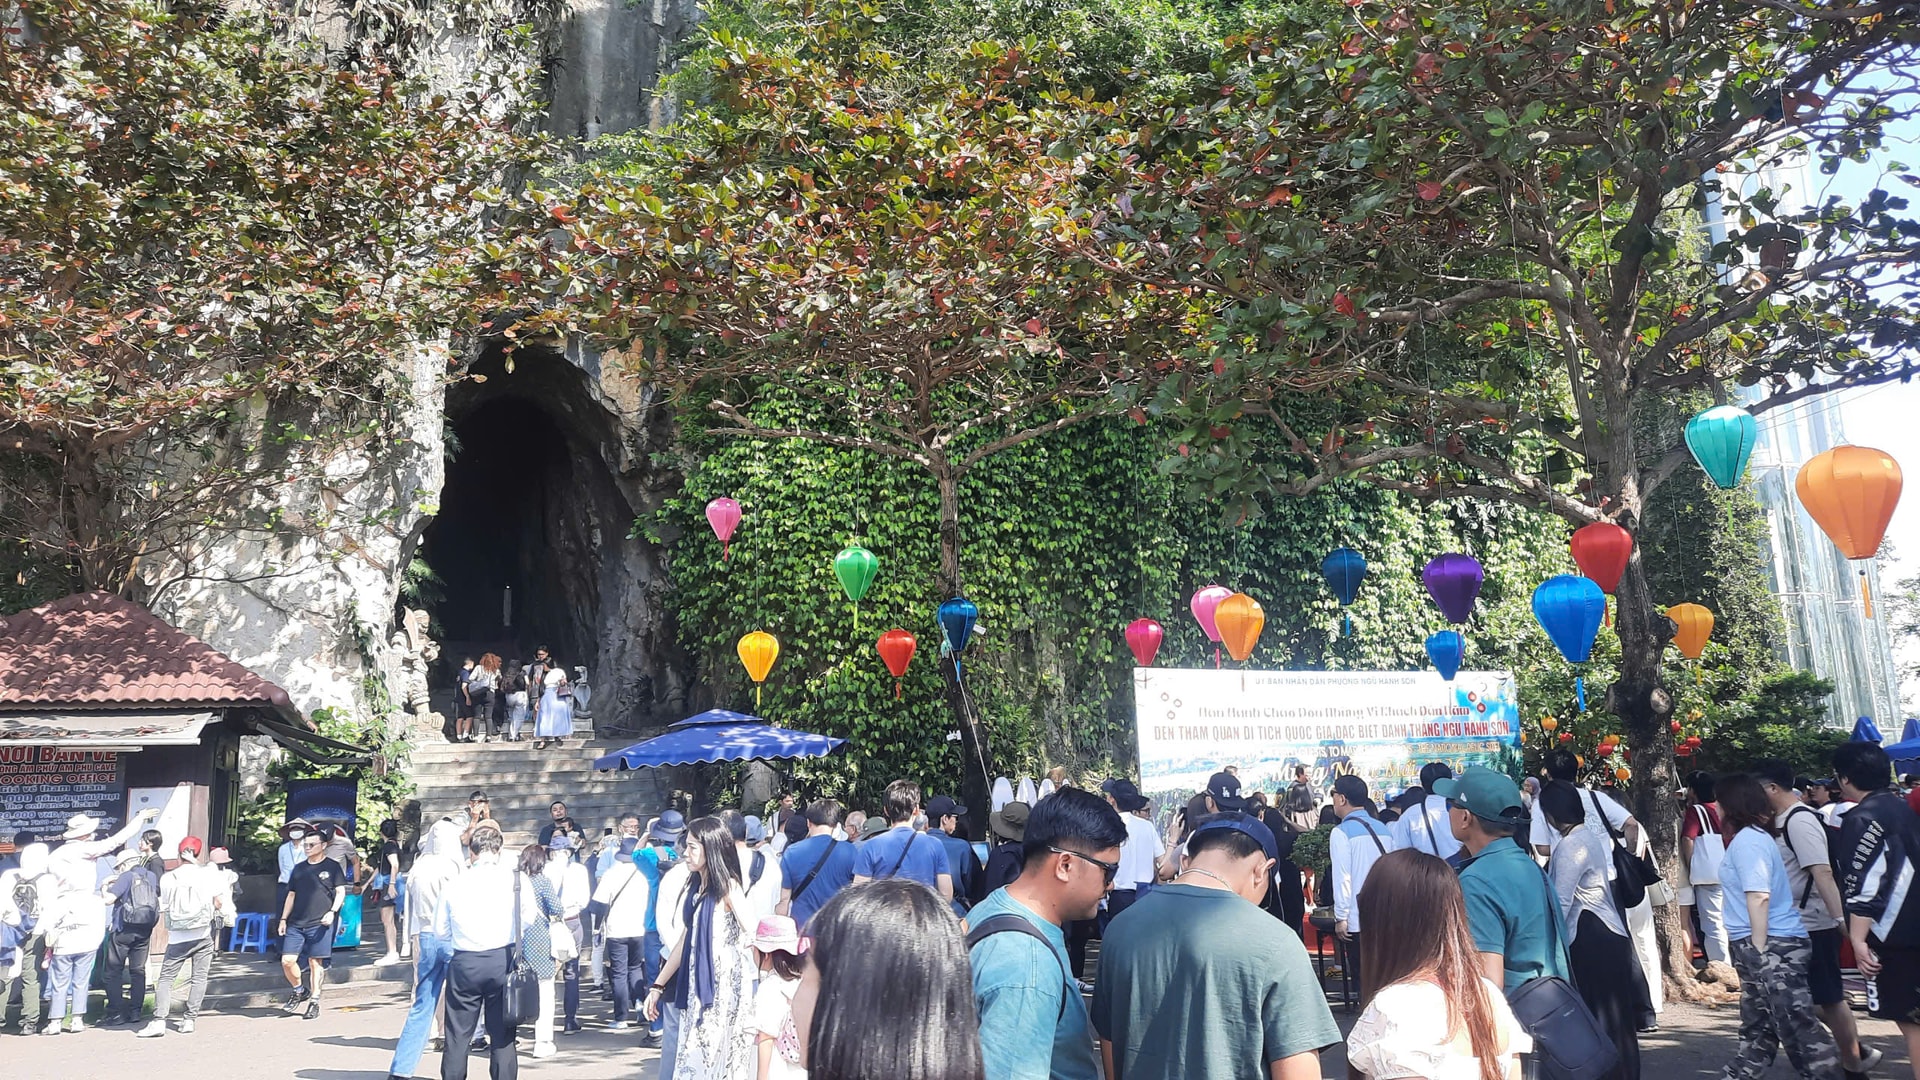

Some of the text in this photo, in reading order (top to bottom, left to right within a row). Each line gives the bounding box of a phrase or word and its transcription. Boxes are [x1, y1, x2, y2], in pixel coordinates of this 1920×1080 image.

[1212, 725, 1240, 742] QUAN
[1243, 725, 1254, 740] DI
[1315, 724, 1333, 740] GIA
[1382, 723, 1407, 738] DANH
[1328, 746, 1340, 757] TO
[94, 763, 116, 772] CAVE
[66, 773, 116, 784] OFFICE
